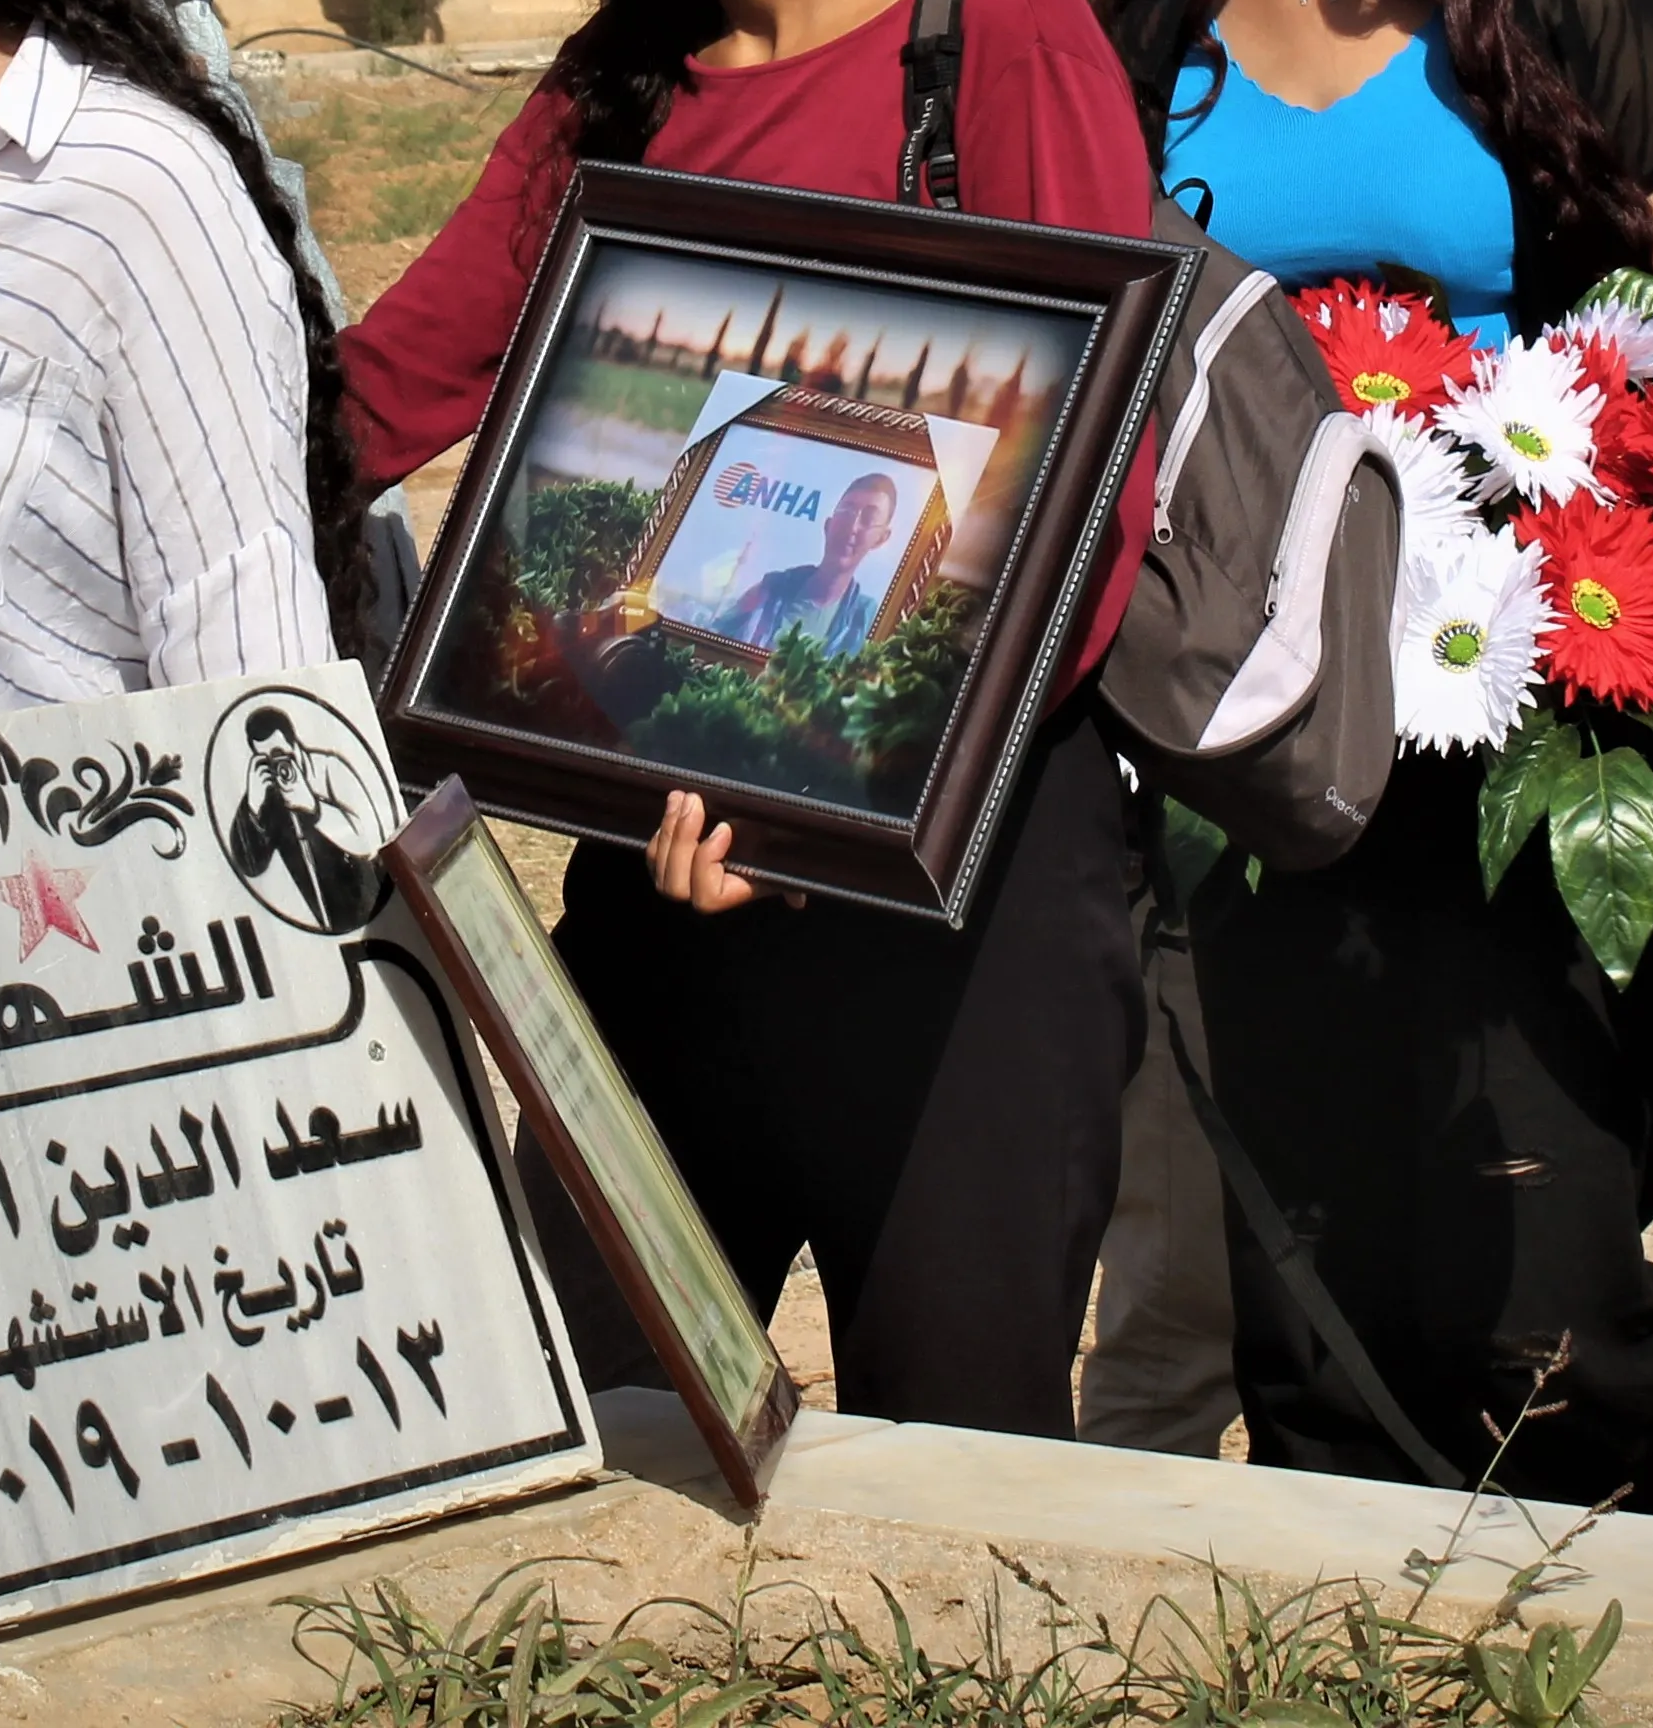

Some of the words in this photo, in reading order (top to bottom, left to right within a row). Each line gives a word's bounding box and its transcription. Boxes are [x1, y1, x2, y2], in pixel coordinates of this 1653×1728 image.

[727, 473, 822, 522] ANHA
[45, 1101, 242, 1257] الدين
[263, 1096, 423, 1180] سعد
[212, 1217, 366, 1348] تاريخ
